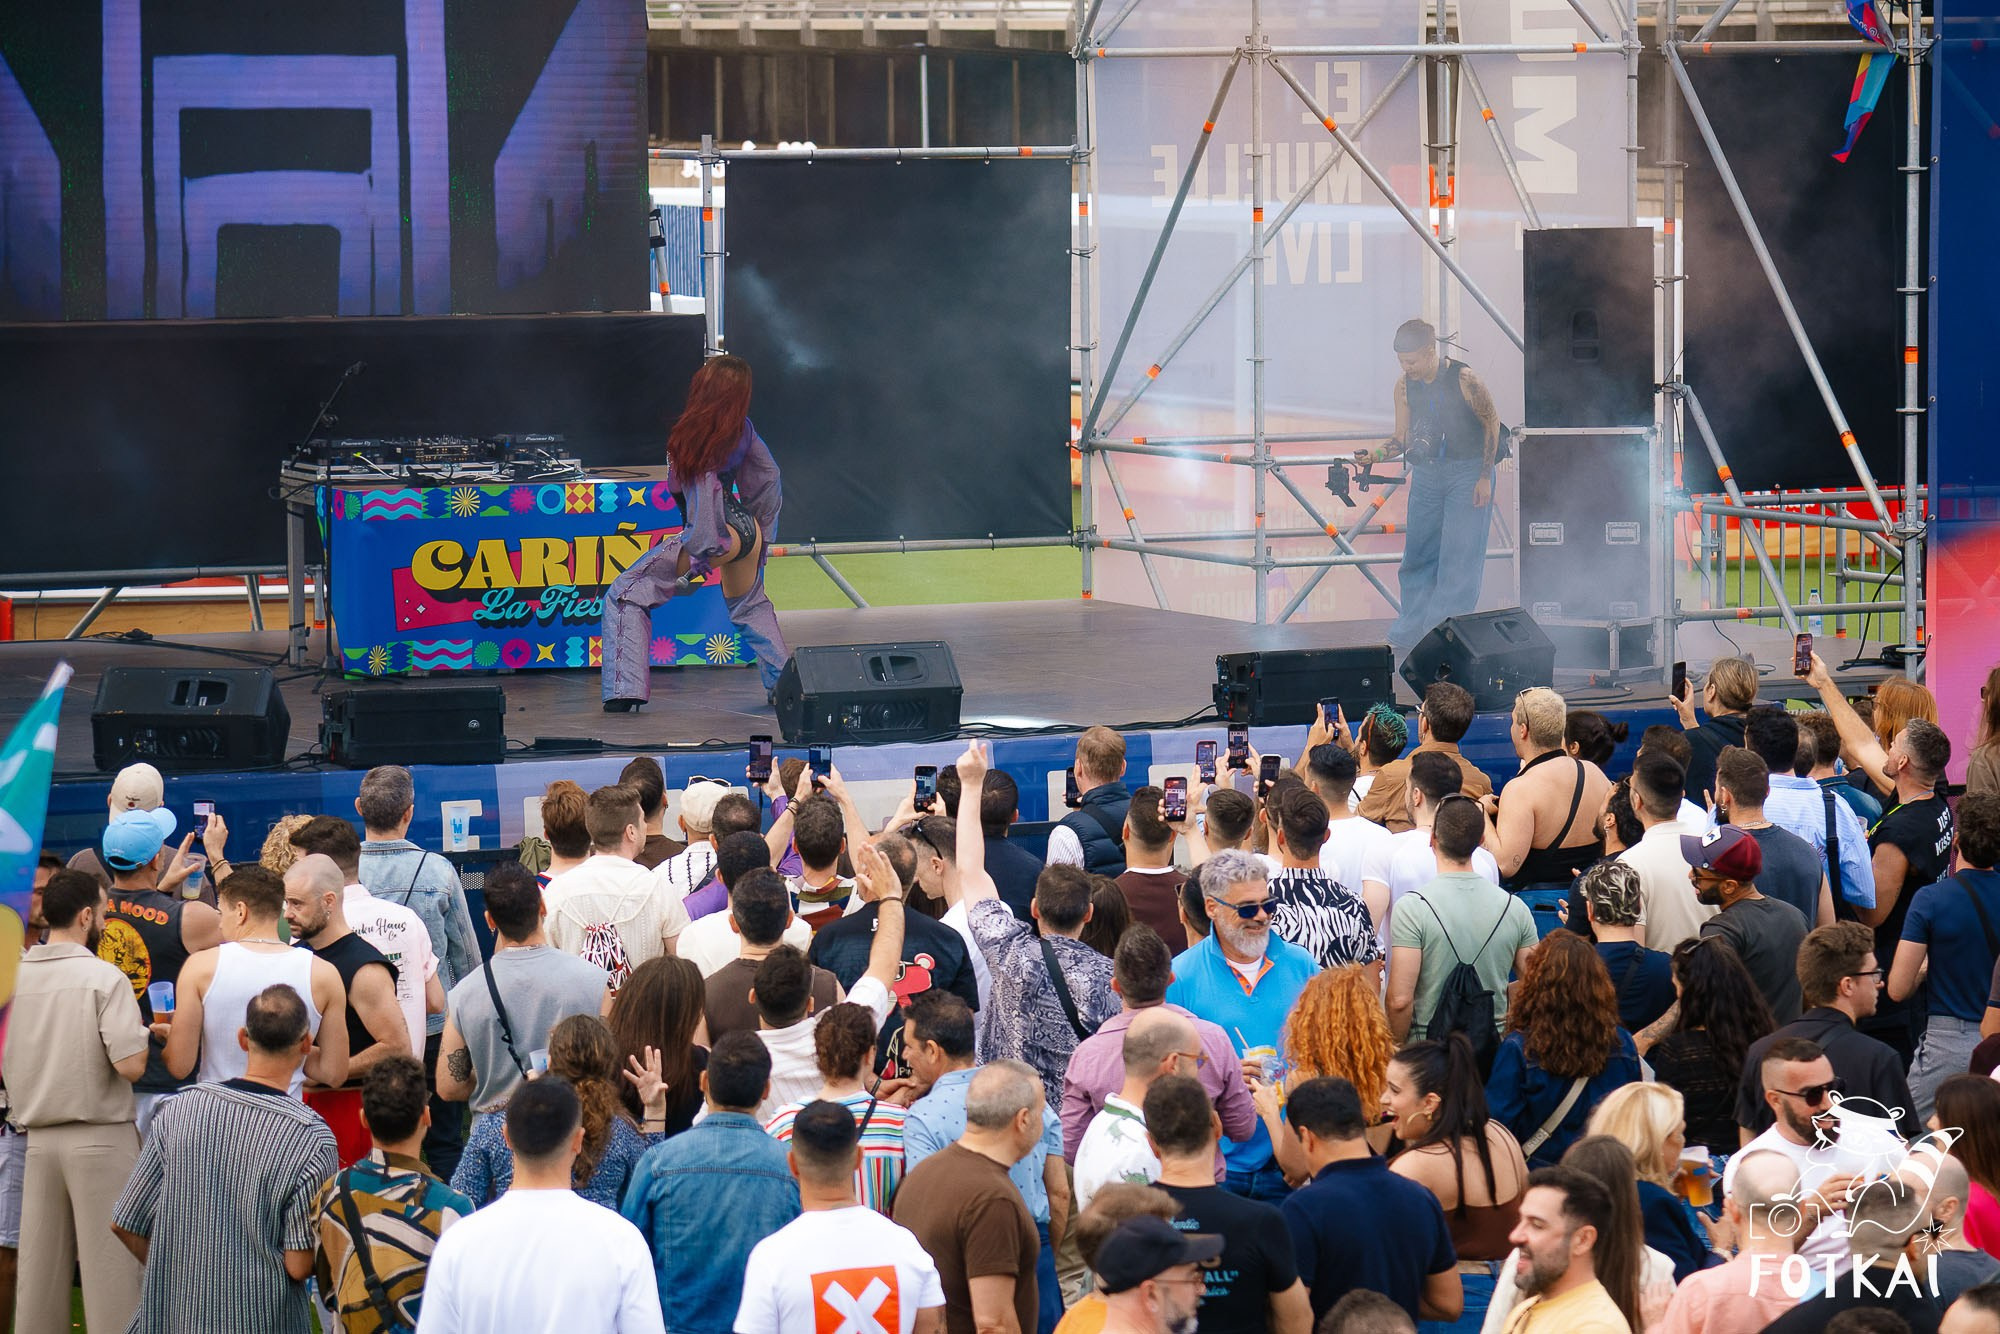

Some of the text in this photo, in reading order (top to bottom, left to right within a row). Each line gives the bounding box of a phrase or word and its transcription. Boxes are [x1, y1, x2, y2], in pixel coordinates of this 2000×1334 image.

[411, 522, 705, 590] CARIÑ
[473, 585, 531, 621] La
[1937, 806, 1951, 833] JUST
[120, 900, 169, 926] MOOD
